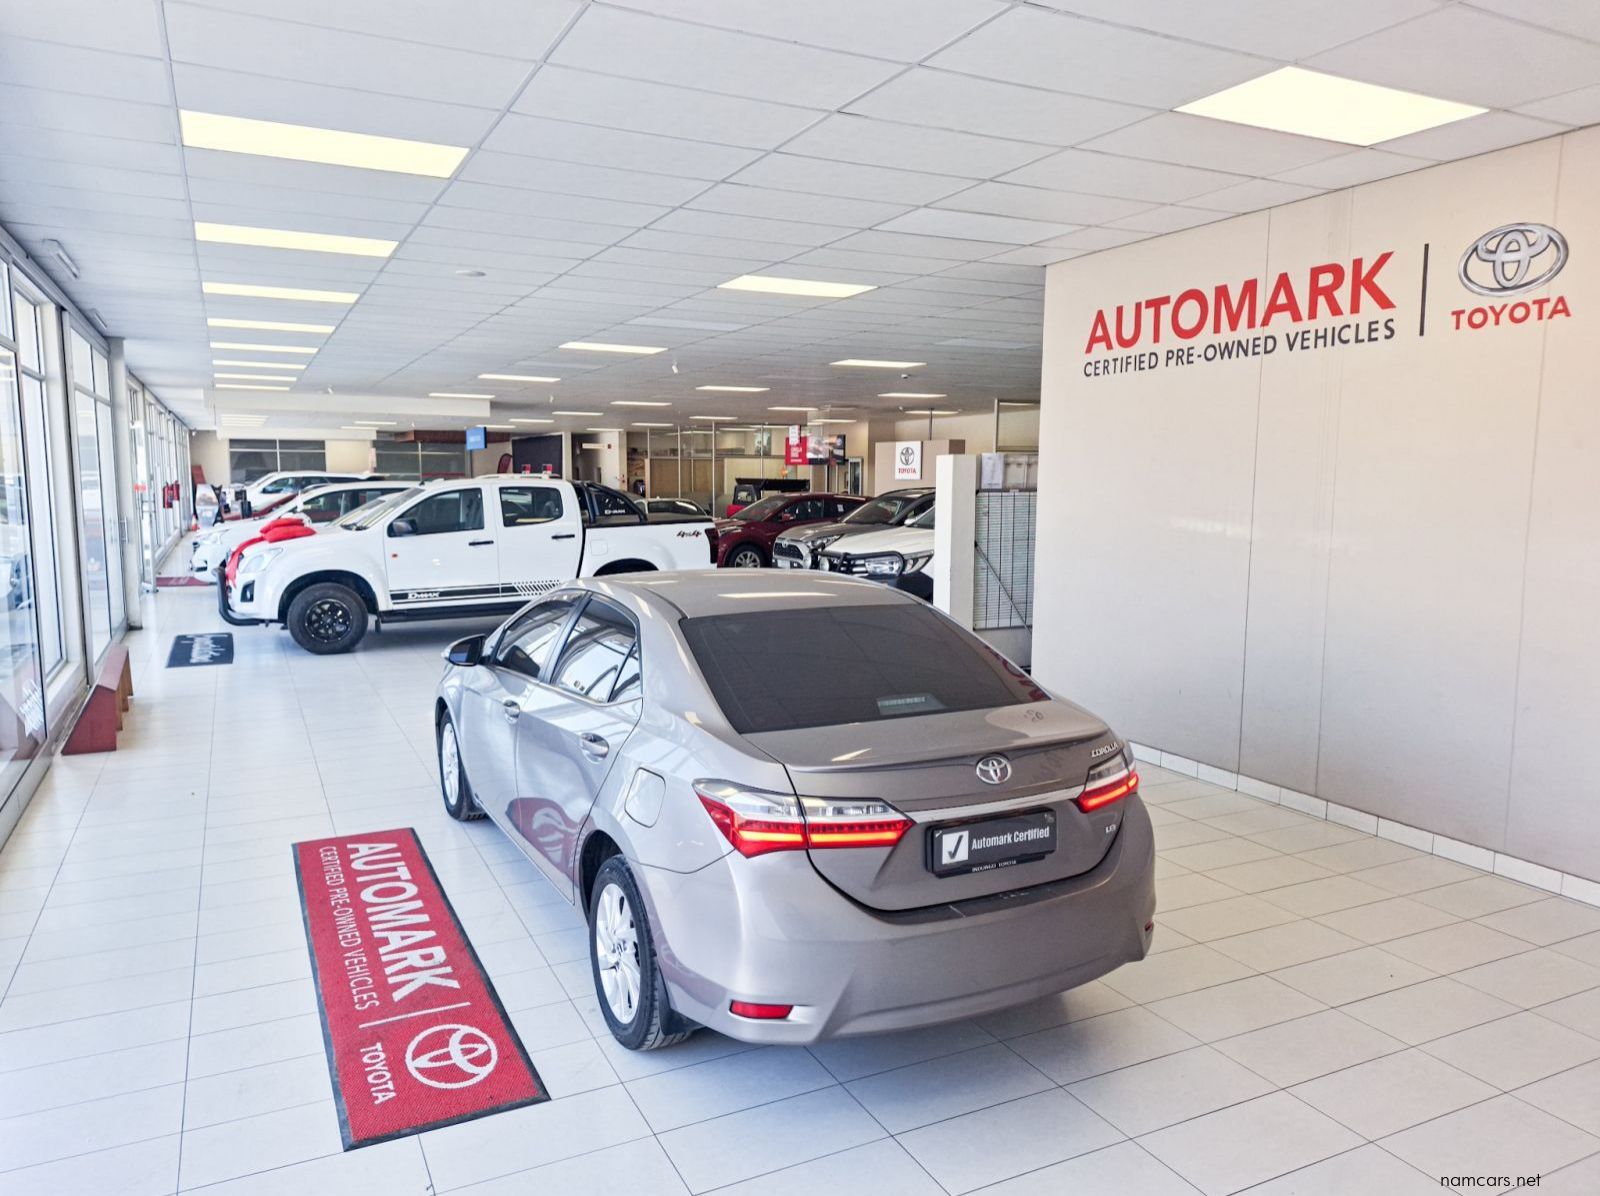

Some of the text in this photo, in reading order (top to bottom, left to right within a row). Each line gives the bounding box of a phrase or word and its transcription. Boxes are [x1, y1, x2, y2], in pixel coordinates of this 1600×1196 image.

[1084, 251, 1397, 354] AUTOMARK
[1451, 295, 1572, 330] TOYOTA
[1083, 318, 1396, 377] CERTIFIED PRE-OWNED VEHICLES
[1091, 741, 1118, 758] COROLLA
[971, 826, 1050, 851] Automark Certified
[319, 846, 380, 1011] CERTIFIED PRE-OWNED VEHICLES
[347, 843, 461, 1002] AUTOMARK
[360, 1042, 397, 1105] TOYOTA
